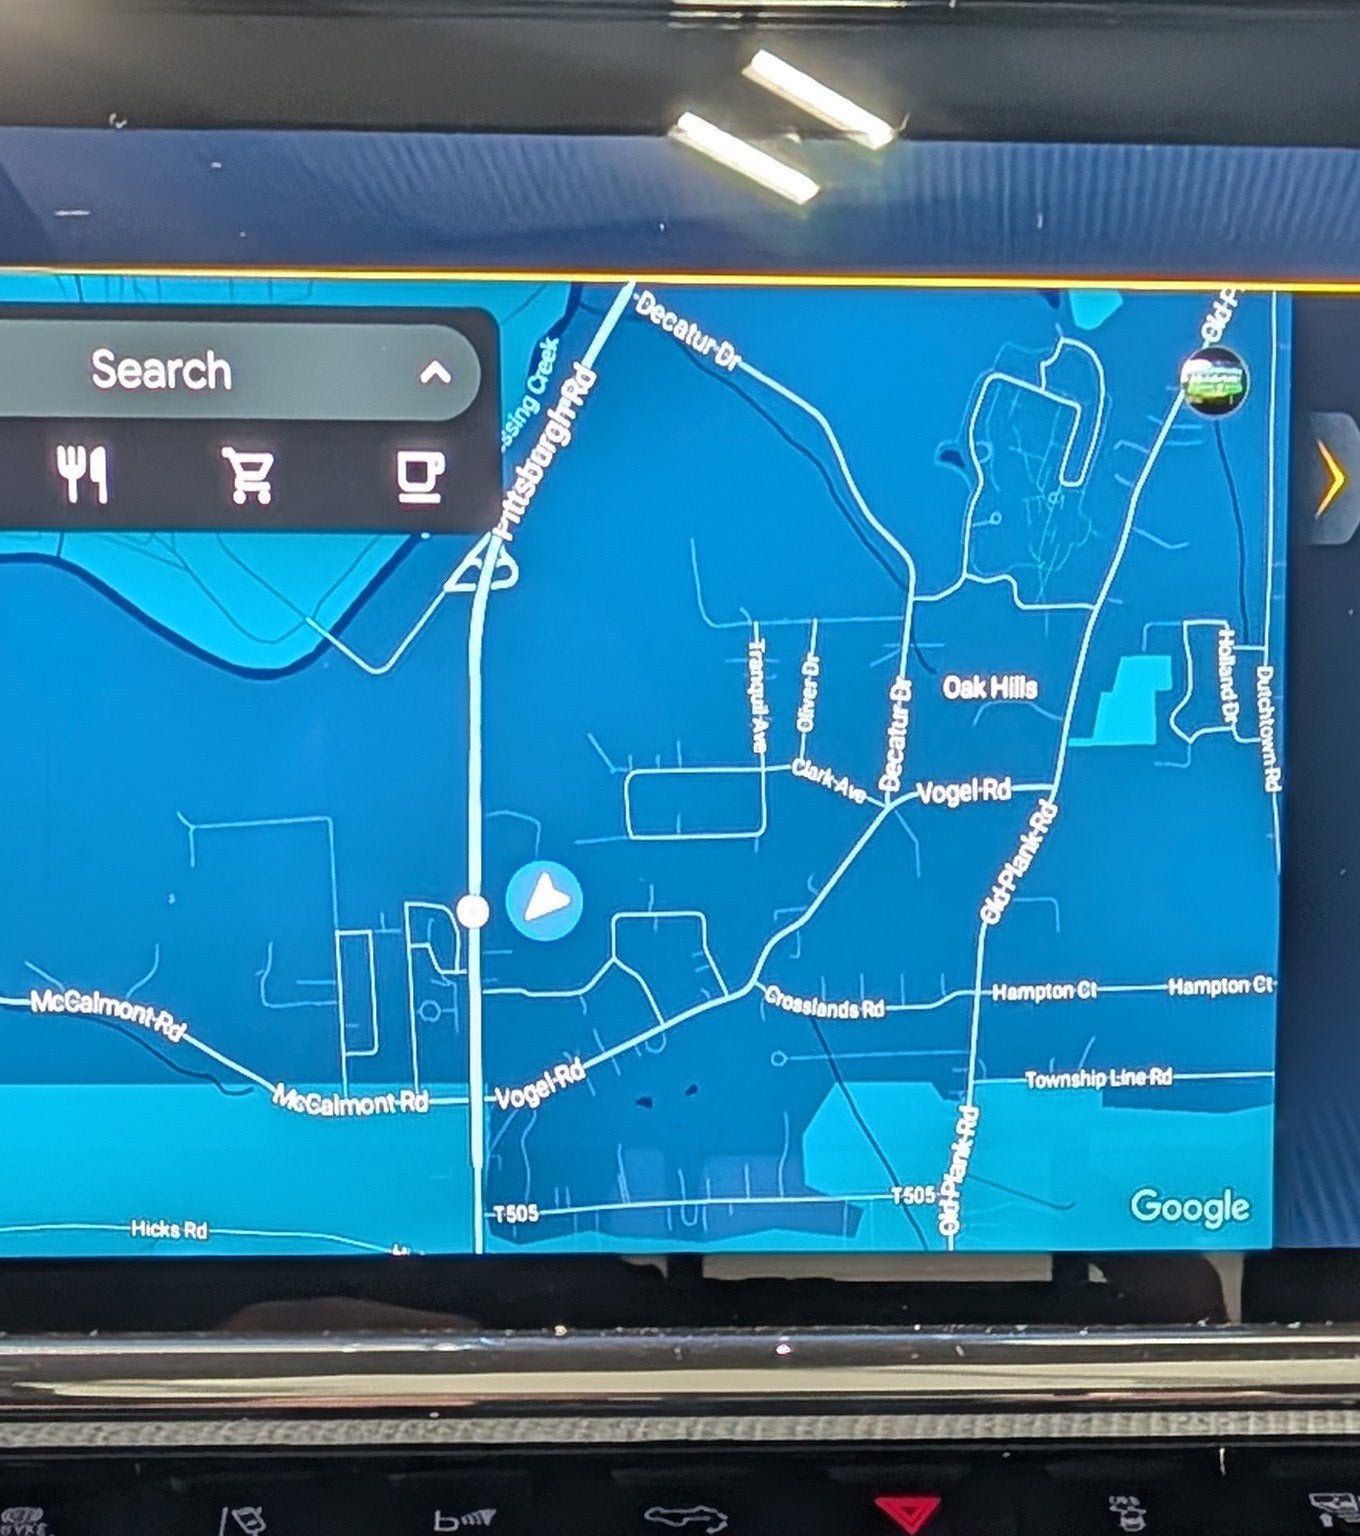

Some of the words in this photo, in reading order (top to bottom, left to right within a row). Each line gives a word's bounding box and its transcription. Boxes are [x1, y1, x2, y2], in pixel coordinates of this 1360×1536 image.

[635, 290, 717, 355] Decatur
[715, 340, 742, 372] Dr
[91, 348, 234, 392] Search
[501, 395, 541, 454] ssing
[526, 336, 559, 394] Creek
[492, 407, 576, 541] Pittsburgh
[560, 361, 597, 406] Rd
[801, 653, 820, 676] Dr
[1218, 629, 1238, 701] Holland
[796, 676, 817, 732] Oliver
[890, 675, 912, 702] Dr
[942, 675, 987, 700] Oak
[990, 675, 1038, 701] Hills
[1222, 702, 1240, 723] Dr
[1256, 666, 1277, 766] Dutchtown
[752, 717, 769, 753] Ave
[878, 703, 908, 792] Decatur
[791, 758, 834, 788] Clark
[834, 777, 868, 805] Ave
[915, 777, 978, 808] Vogel
[982, 776, 1012, 801] Rd
[1264, 767, 1282, 793] Rd
[980, 885, 1011, 925] Old
[997, 832, 1043, 892] Plank
[1029, 798, 1058, 833] Rd
[765, 985, 860, 1018] Crosslands
[861, 998, 885, 1019] Rd
[992, 981, 1074, 1003] Hampton
[1077, 979, 1099, 999] Ct
[1168, 977, 1250, 998] Hampton
[1252, 974, 1274, 994] Ct
[30, 988, 153, 1025] McCalmont
[154, 1009, 189, 1044] Rd
[494, 1070, 556, 1110] Vogel
[554, 1056, 587, 1089] Rd
[1025, 1068, 1107, 1091] Township
[1109, 1067, 1147, 1087] Line
[1149, 1066, 1173, 1086] Rd
[271, 1081, 396, 1117] McCalmont
[400, 1088, 431, 1115] Rd
[955, 1105, 980, 1137] Rd
[940, 1139, 974, 1199] Plank
[891, 1185, 936, 1205] T505
[1130, 1188, 1251, 1230] Google
[131, 1219, 182, 1239] Hicks
[184, 1220, 209, 1240] Rd
[494, 1204, 539, 1223] T505
